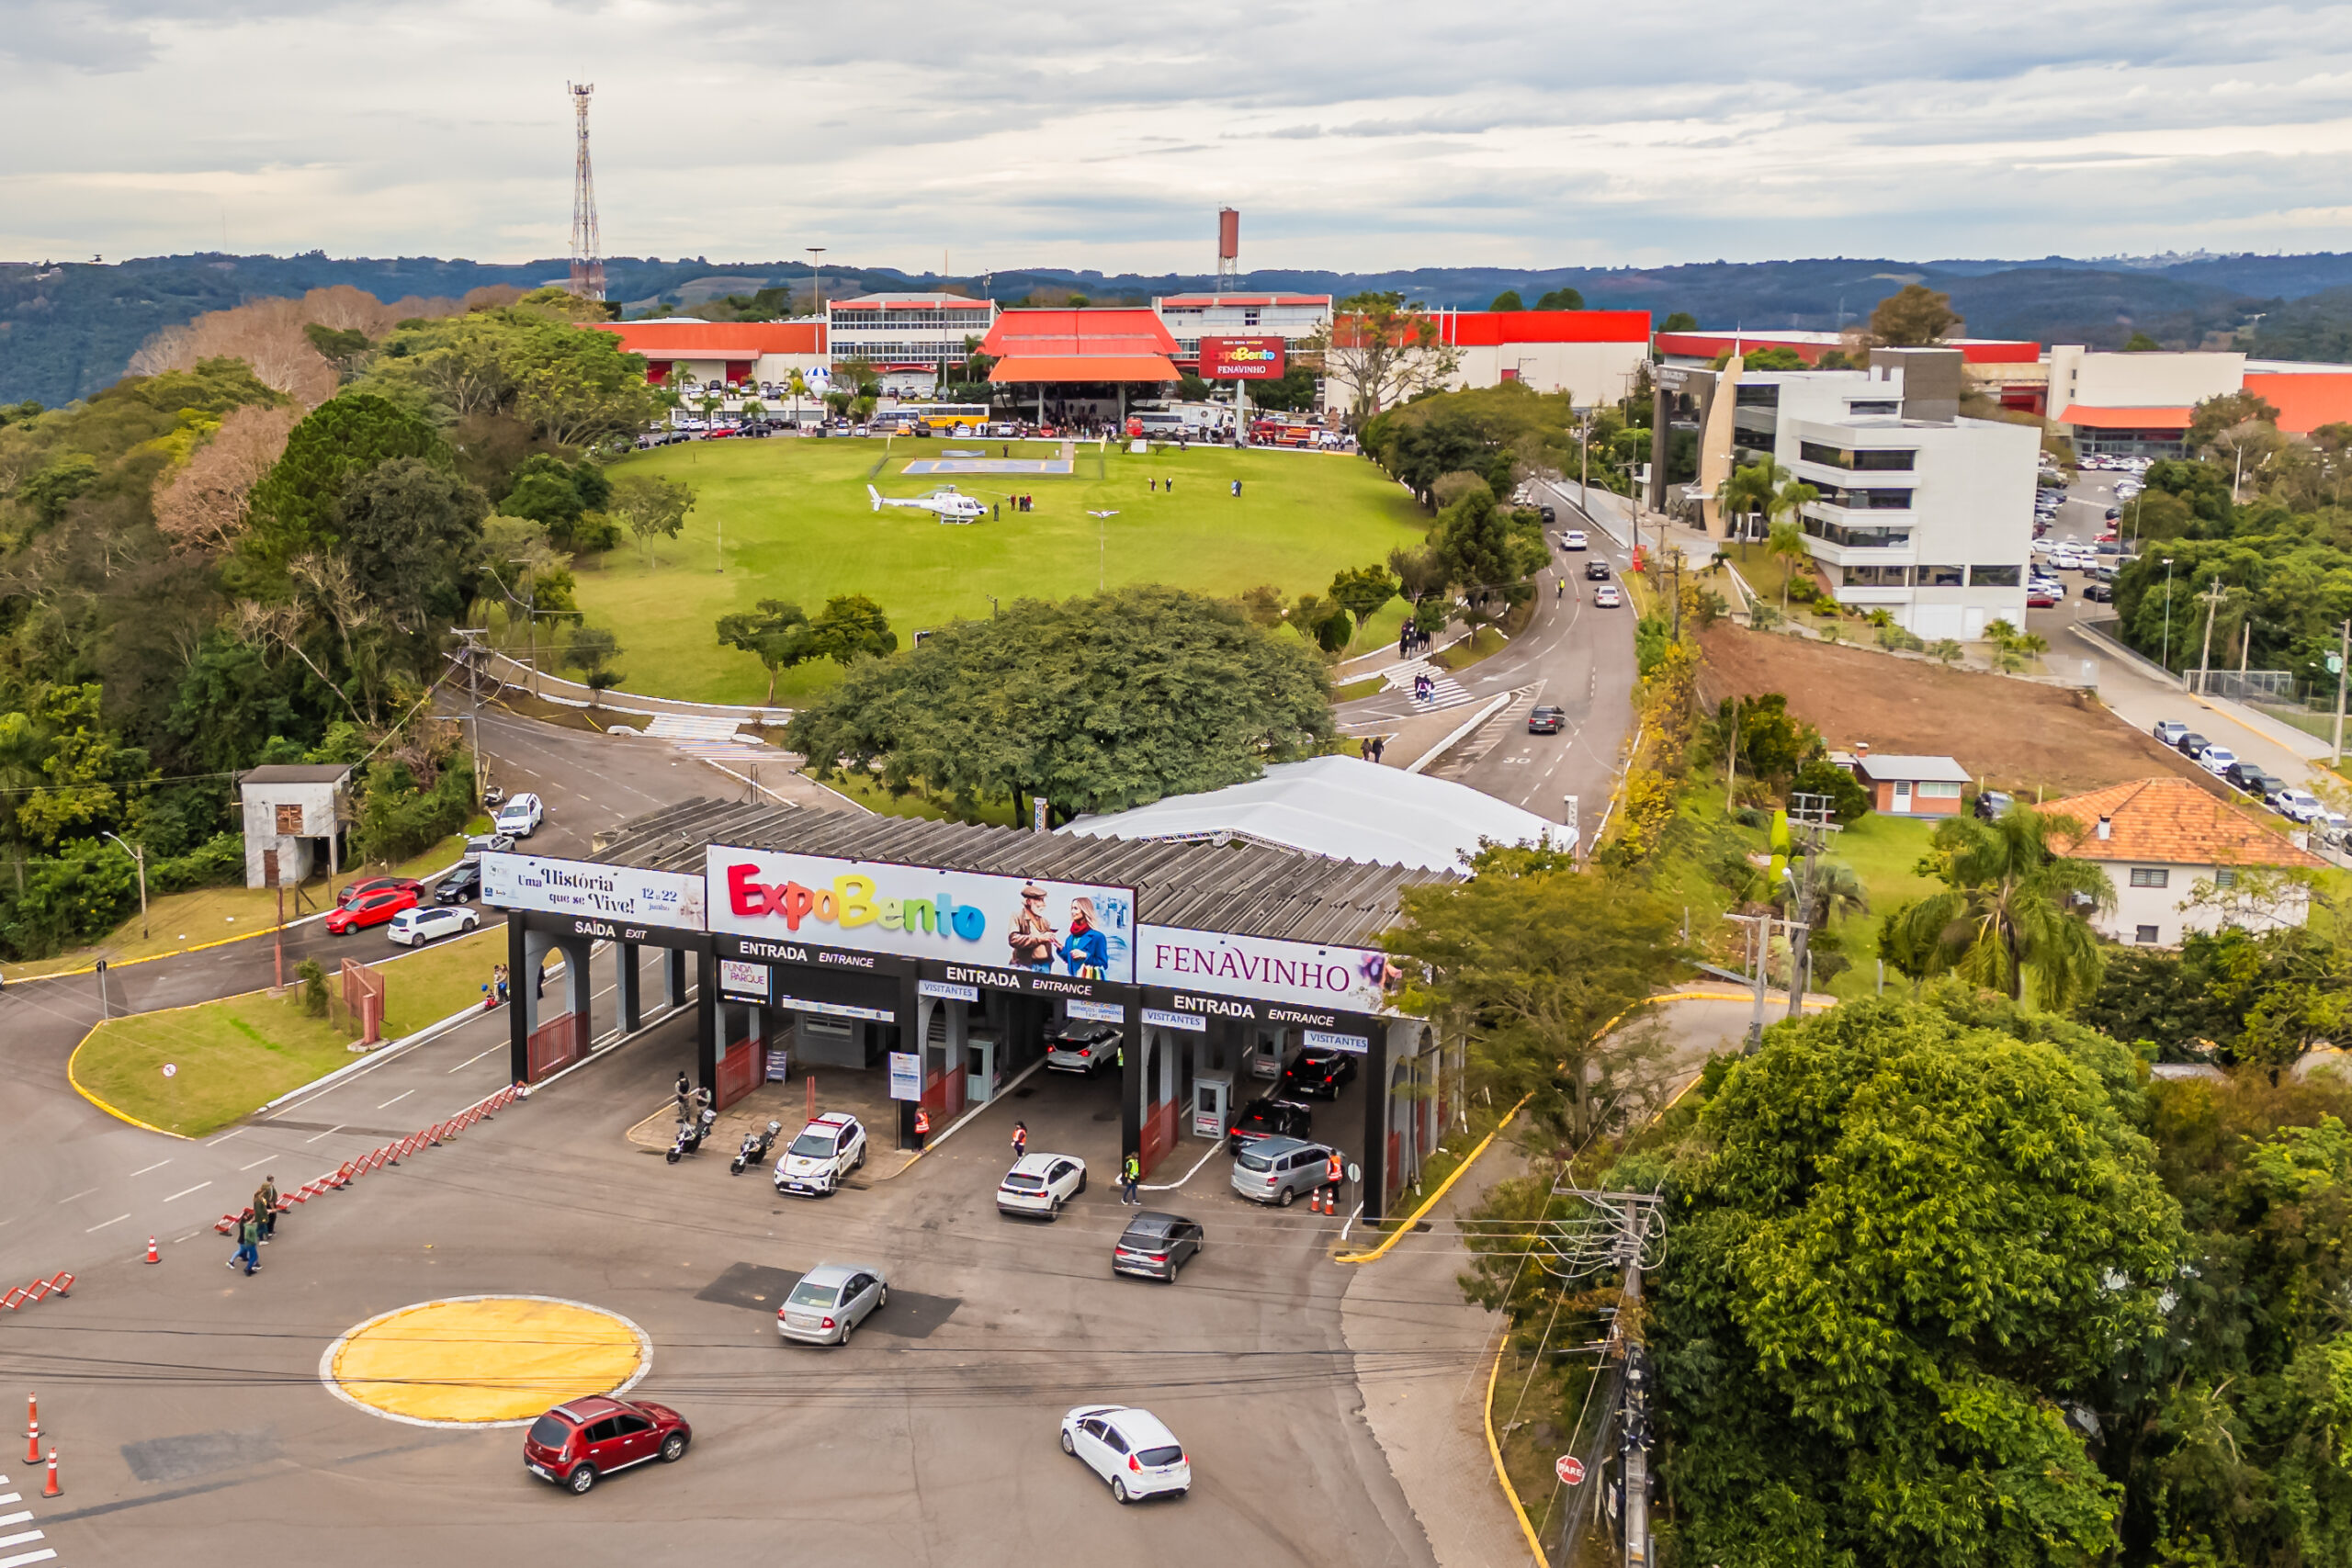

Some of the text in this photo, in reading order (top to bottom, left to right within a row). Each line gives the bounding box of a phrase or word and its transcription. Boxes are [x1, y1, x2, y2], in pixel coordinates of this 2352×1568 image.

[1217, 365, 1266, 374] FENAVINHO
[518, 867, 614, 892] Uma História
[548, 893, 635, 914] que se Vive!
[642, 887, 654, 899] 12
[662, 889, 678, 902] 22
[728, 863, 985, 941] ExpoBento
[575, 919, 648, 940] SAÍDA EXIT
[740, 942, 875, 968] ENTRADA ENTRANCE
[730, 972, 765, 985] PARQUE
[1155, 944, 1351, 992] FENAVINHO
[924, 983, 973, 998] VISITANTES
[946, 966, 1093, 997] ENTRADA ENTRANCE
[1148, 1011, 1201, 1027] VISITANTES
[1173, 995, 1335, 1027] ENTRADA ENTRANCE
[1310, 1032, 1367, 1048] VISITANTES
[1559, 1463, 1583, 1477] PARE
